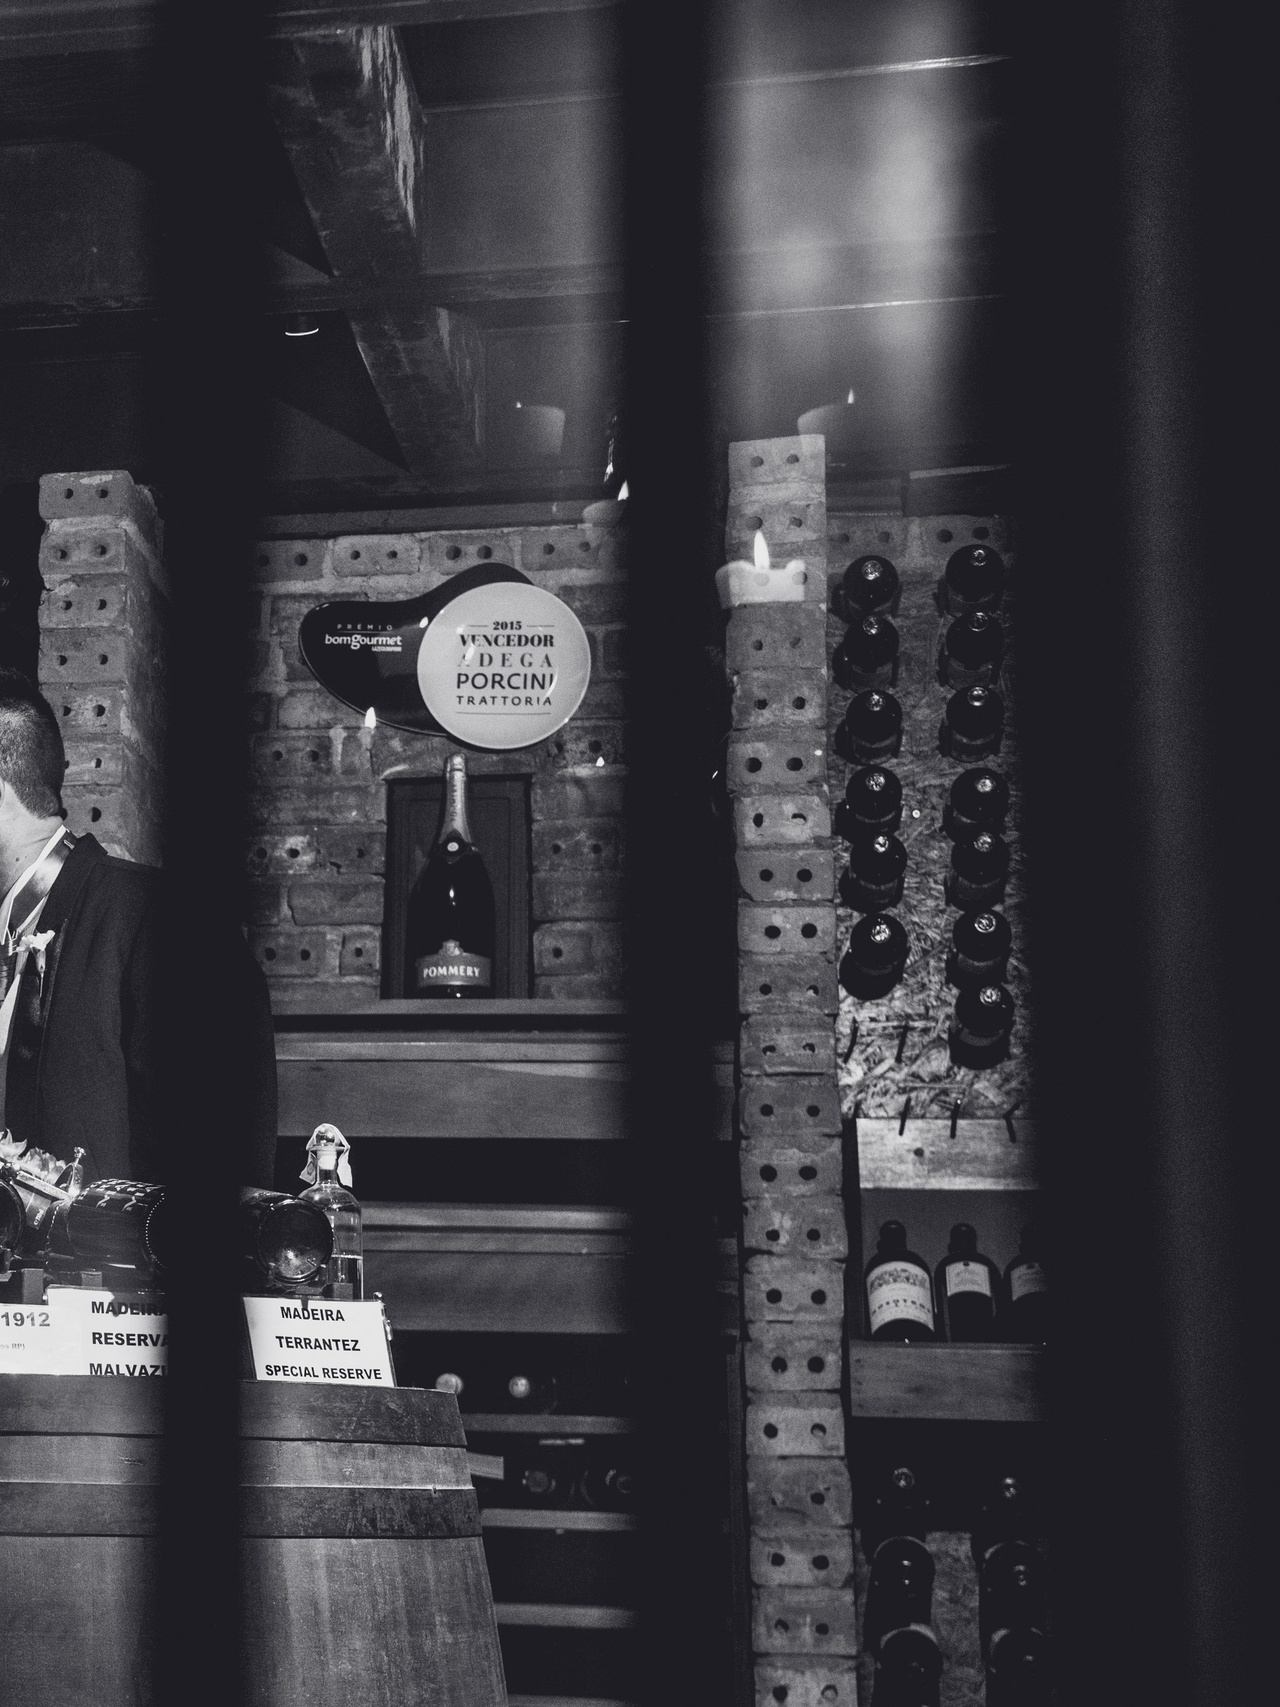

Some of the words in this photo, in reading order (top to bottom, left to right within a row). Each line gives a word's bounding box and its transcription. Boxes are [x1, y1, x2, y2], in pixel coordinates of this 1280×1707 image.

[492, 620, 523, 631] 2015
[459, 633, 555, 648] VENCEDOR
[456, 672, 555, 690] PORCINI
[456, 695, 553, 707] TRATTORIA
[423, 965, 480, 978] POMMERY
[91, 1300, 166, 1317] MADEIR
[279, 1306, 346, 1322] MADEIRA
[0, 1311, 51, 1328] 1912
[275, 1335, 361, 1352] TERRANTEZ
[264, 1363, 320, 1379] SPECIAL
[321, 1366, 383, 1380] RESERVE
